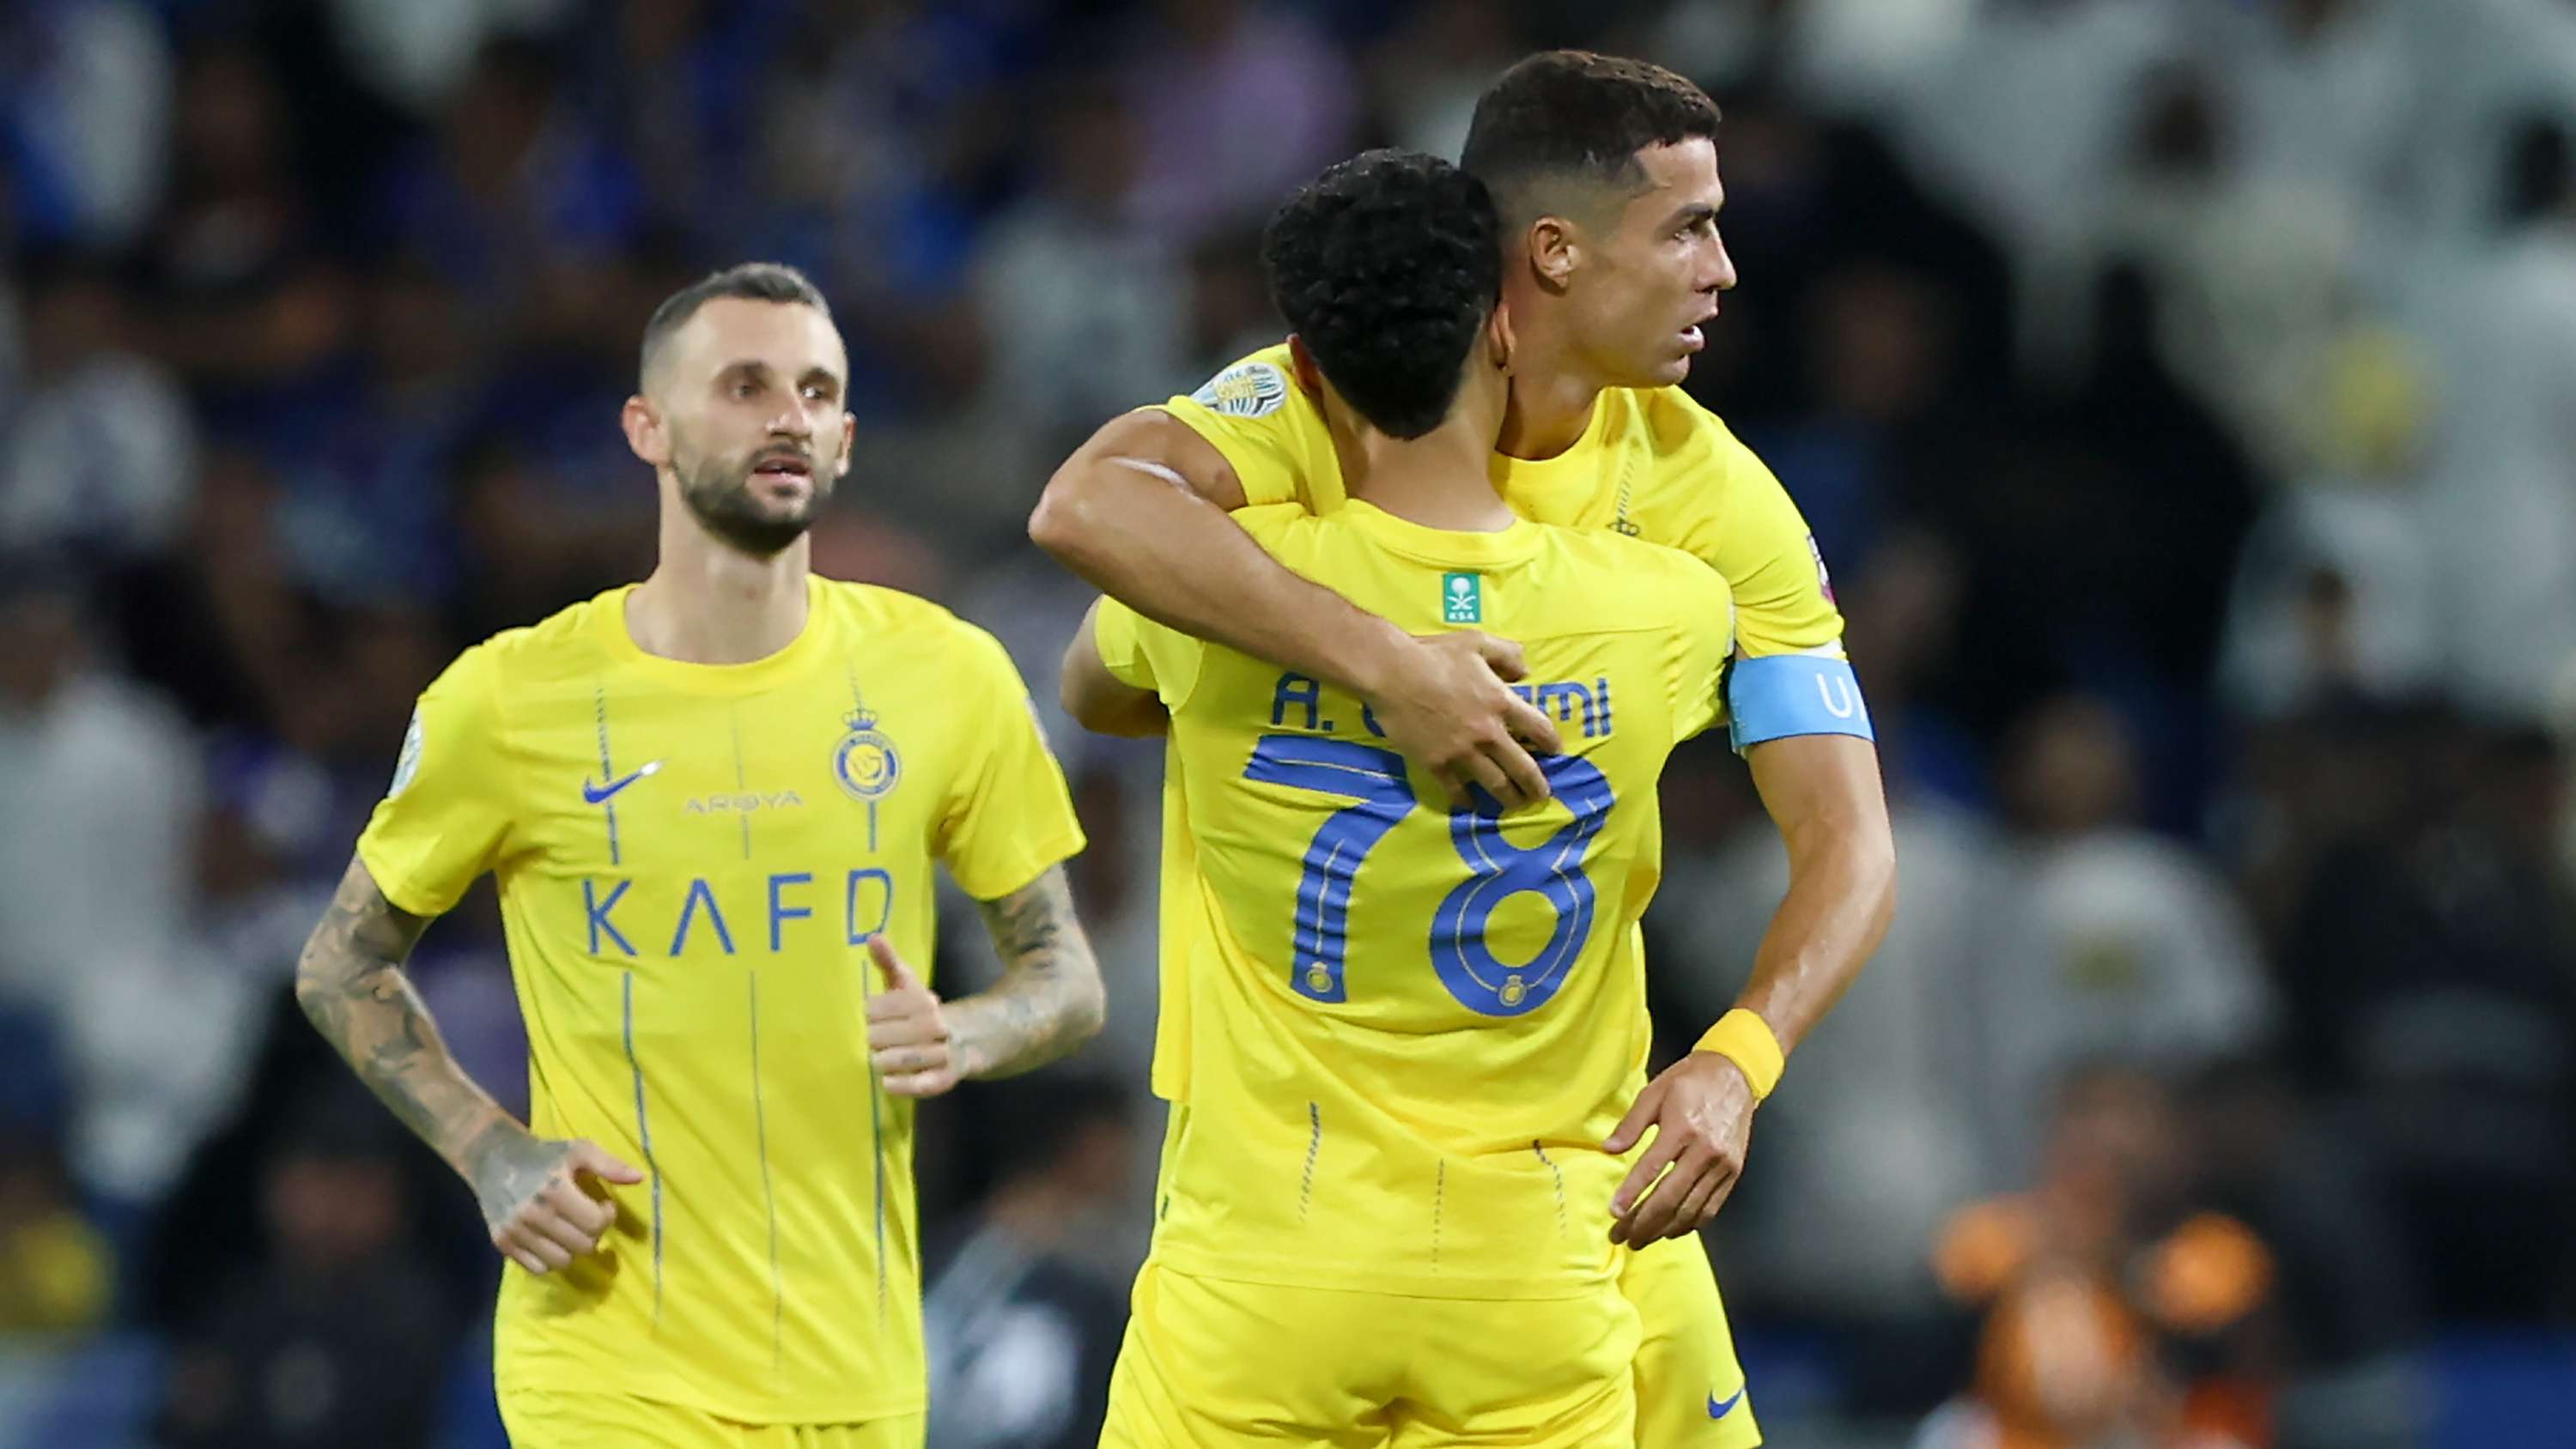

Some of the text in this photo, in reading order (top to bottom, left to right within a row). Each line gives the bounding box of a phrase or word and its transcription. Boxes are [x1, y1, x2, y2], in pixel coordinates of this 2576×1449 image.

[1273, 672, 1333, 731] A.
[684, 790, 801, 815] AROYA
[582, 868, 892, 956] KAFD
[1242, 735, 1615, 1016] 78
